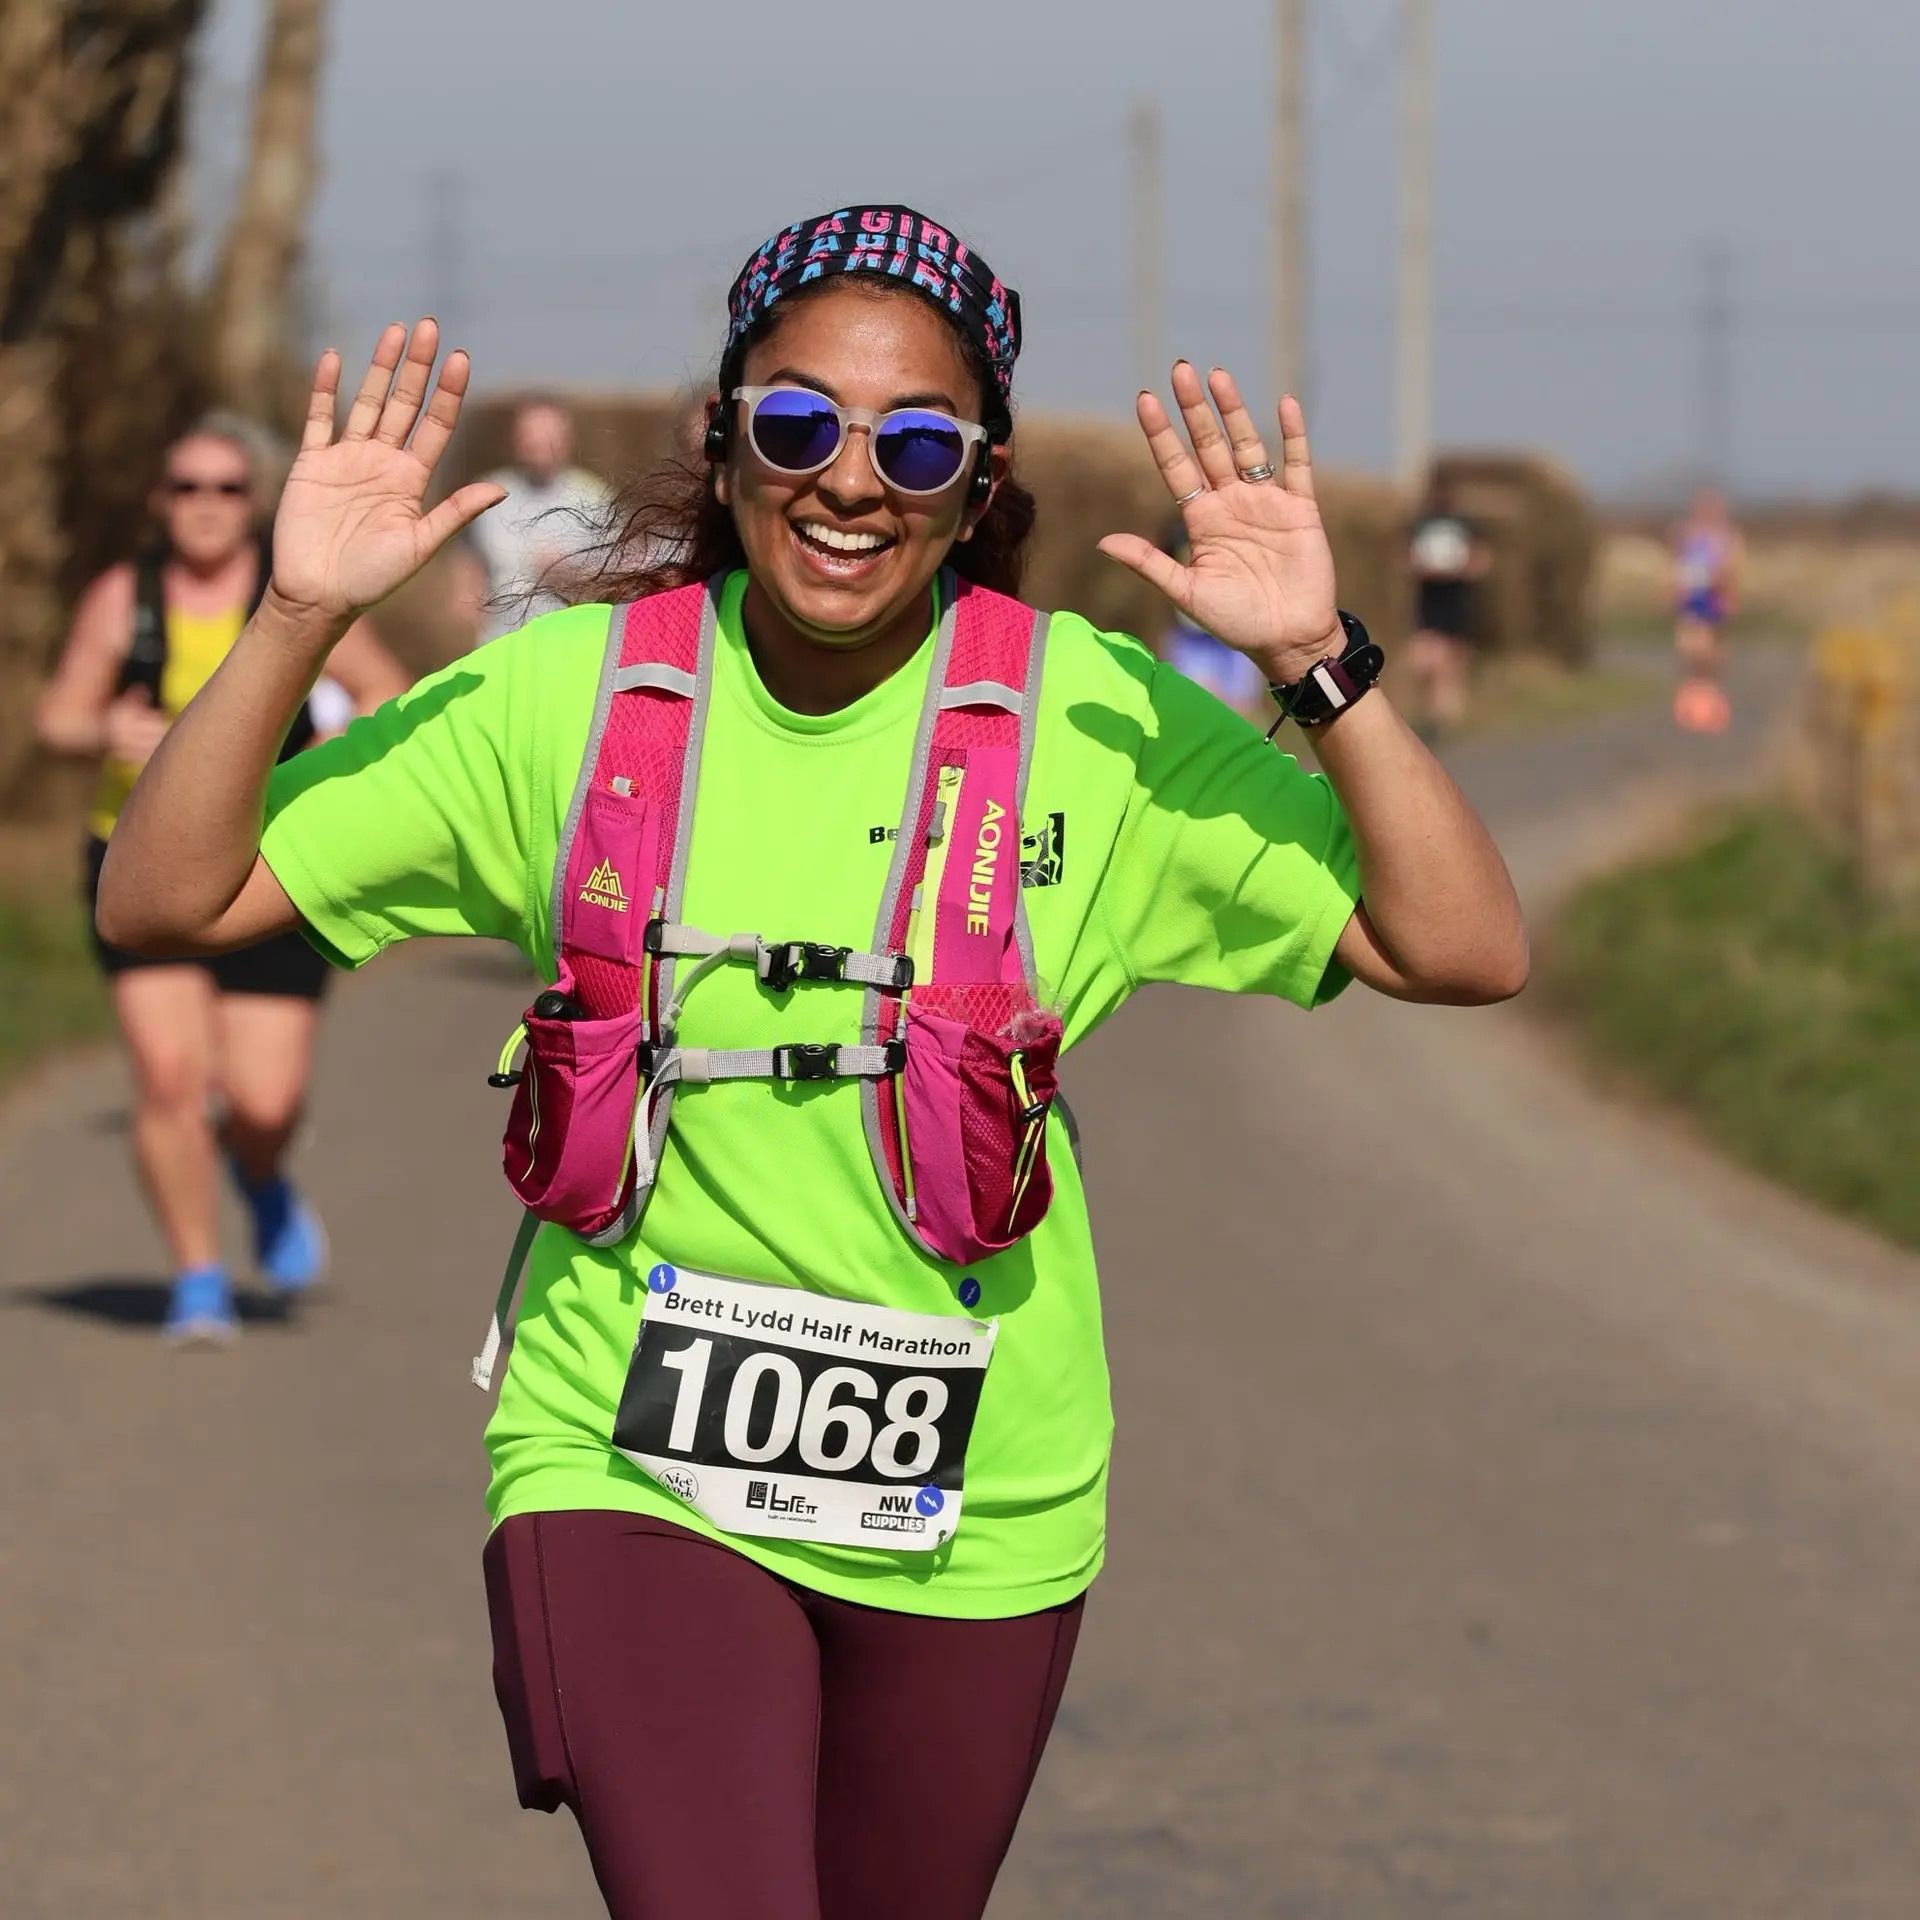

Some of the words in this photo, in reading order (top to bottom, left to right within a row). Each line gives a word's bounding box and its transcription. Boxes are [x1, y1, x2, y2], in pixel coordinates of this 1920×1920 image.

[967, 799, 1006, 937] AONIJIE
[578, 890, 629, 913] AONIJIE
[664, 1292, 724, 1320] Brett
[731, 1302, 792, 1332] Lydd
[800, 1318, 852, 1345] Half
[859, 1330, 971, 1356] Marathon
[661, 1337, 949, 1479] 1068
[664, 1472, 693, 1488] Nice
[879, 1496, 912, 1513] NW
[863, 1514, 924, 1532] SUPPLIES
